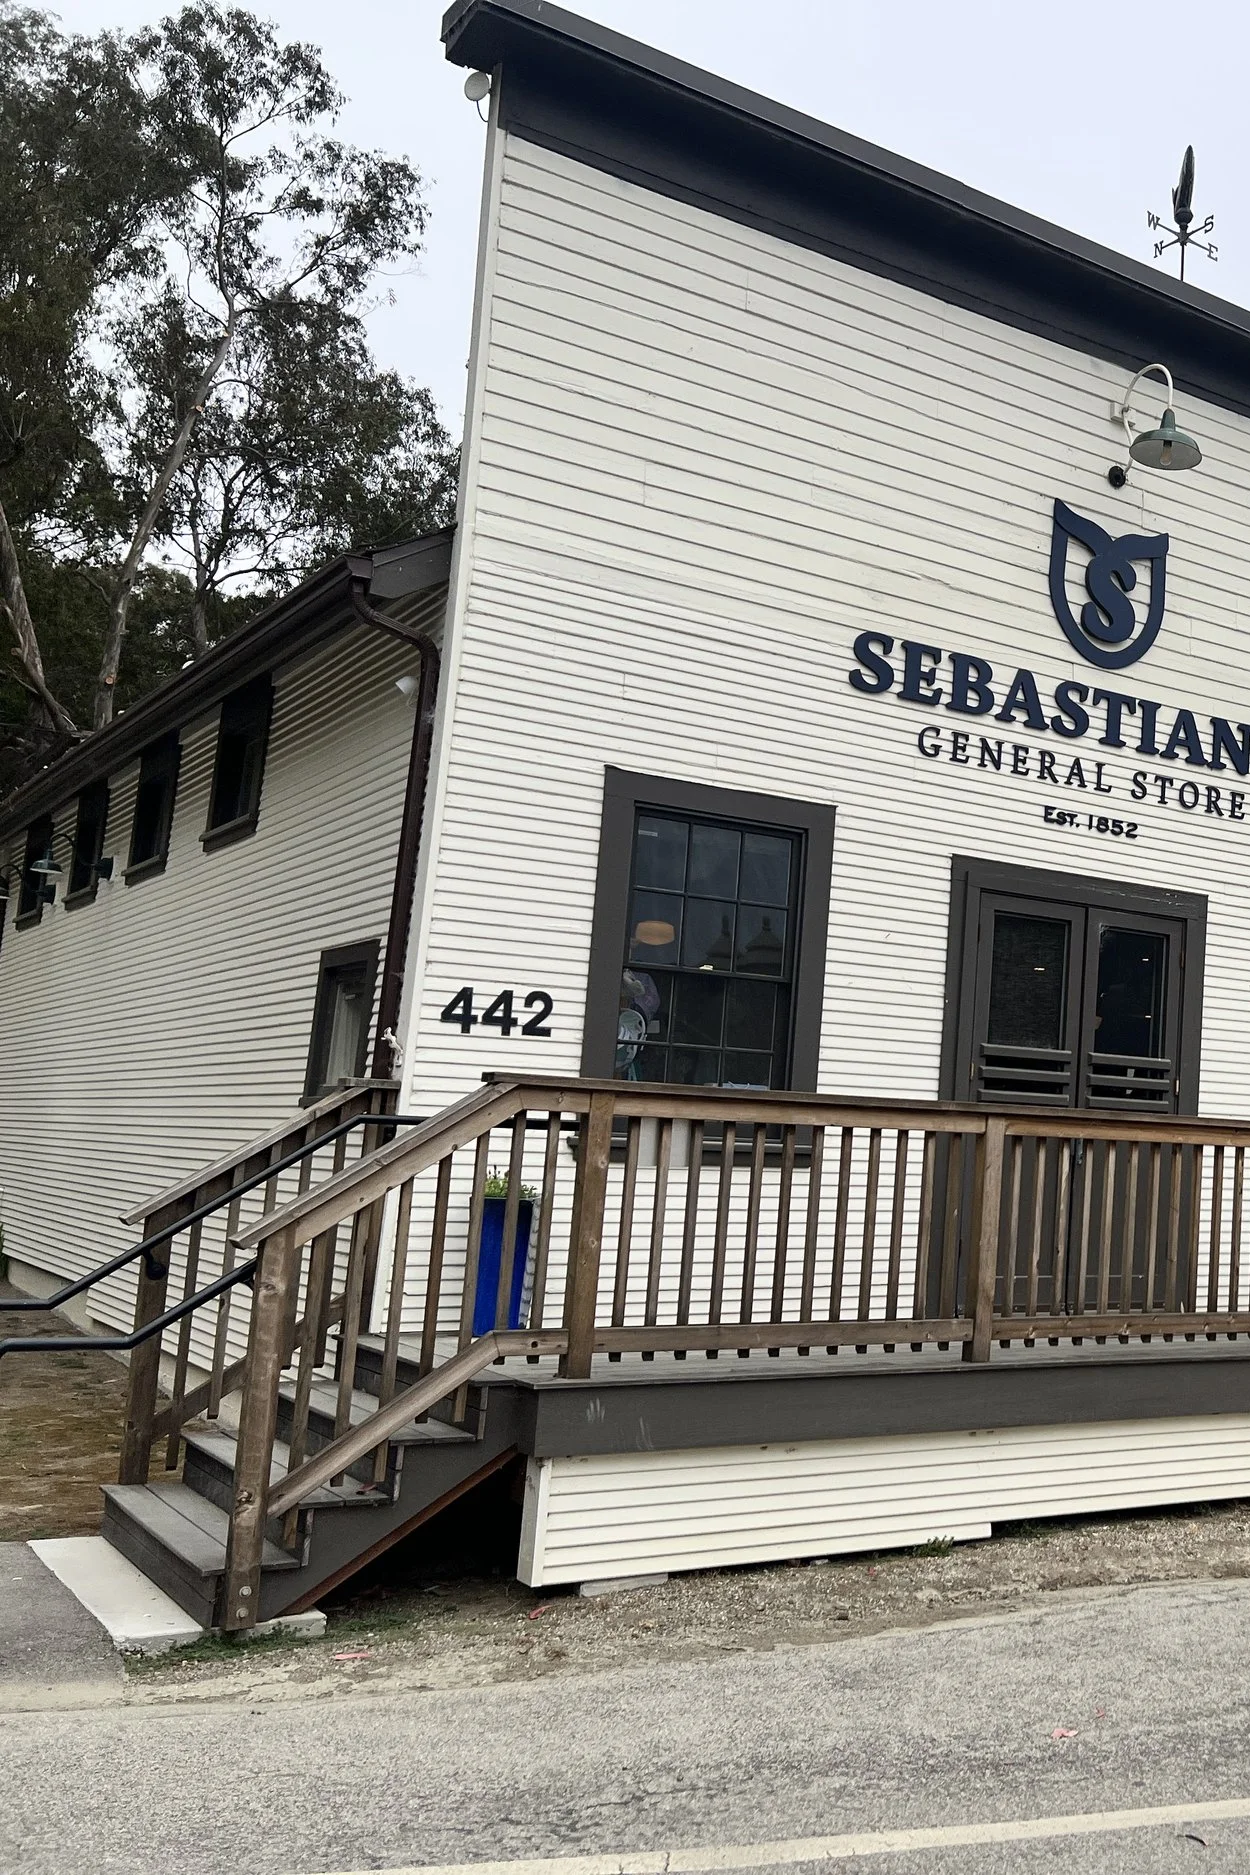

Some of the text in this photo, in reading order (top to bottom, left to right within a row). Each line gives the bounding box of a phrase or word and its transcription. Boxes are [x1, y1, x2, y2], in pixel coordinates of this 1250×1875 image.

[1147, 210, 1160, 231] W
[1204, 214, 1214, 234] S
[1153, 240, 1164, 258] N
[1207, 242, 1218, 262] E
[917, 725, 1246, 820] GENERAL STORE
[1088, 814, 1138, 839] 1852
[440, 986, 554, 1037] 442
